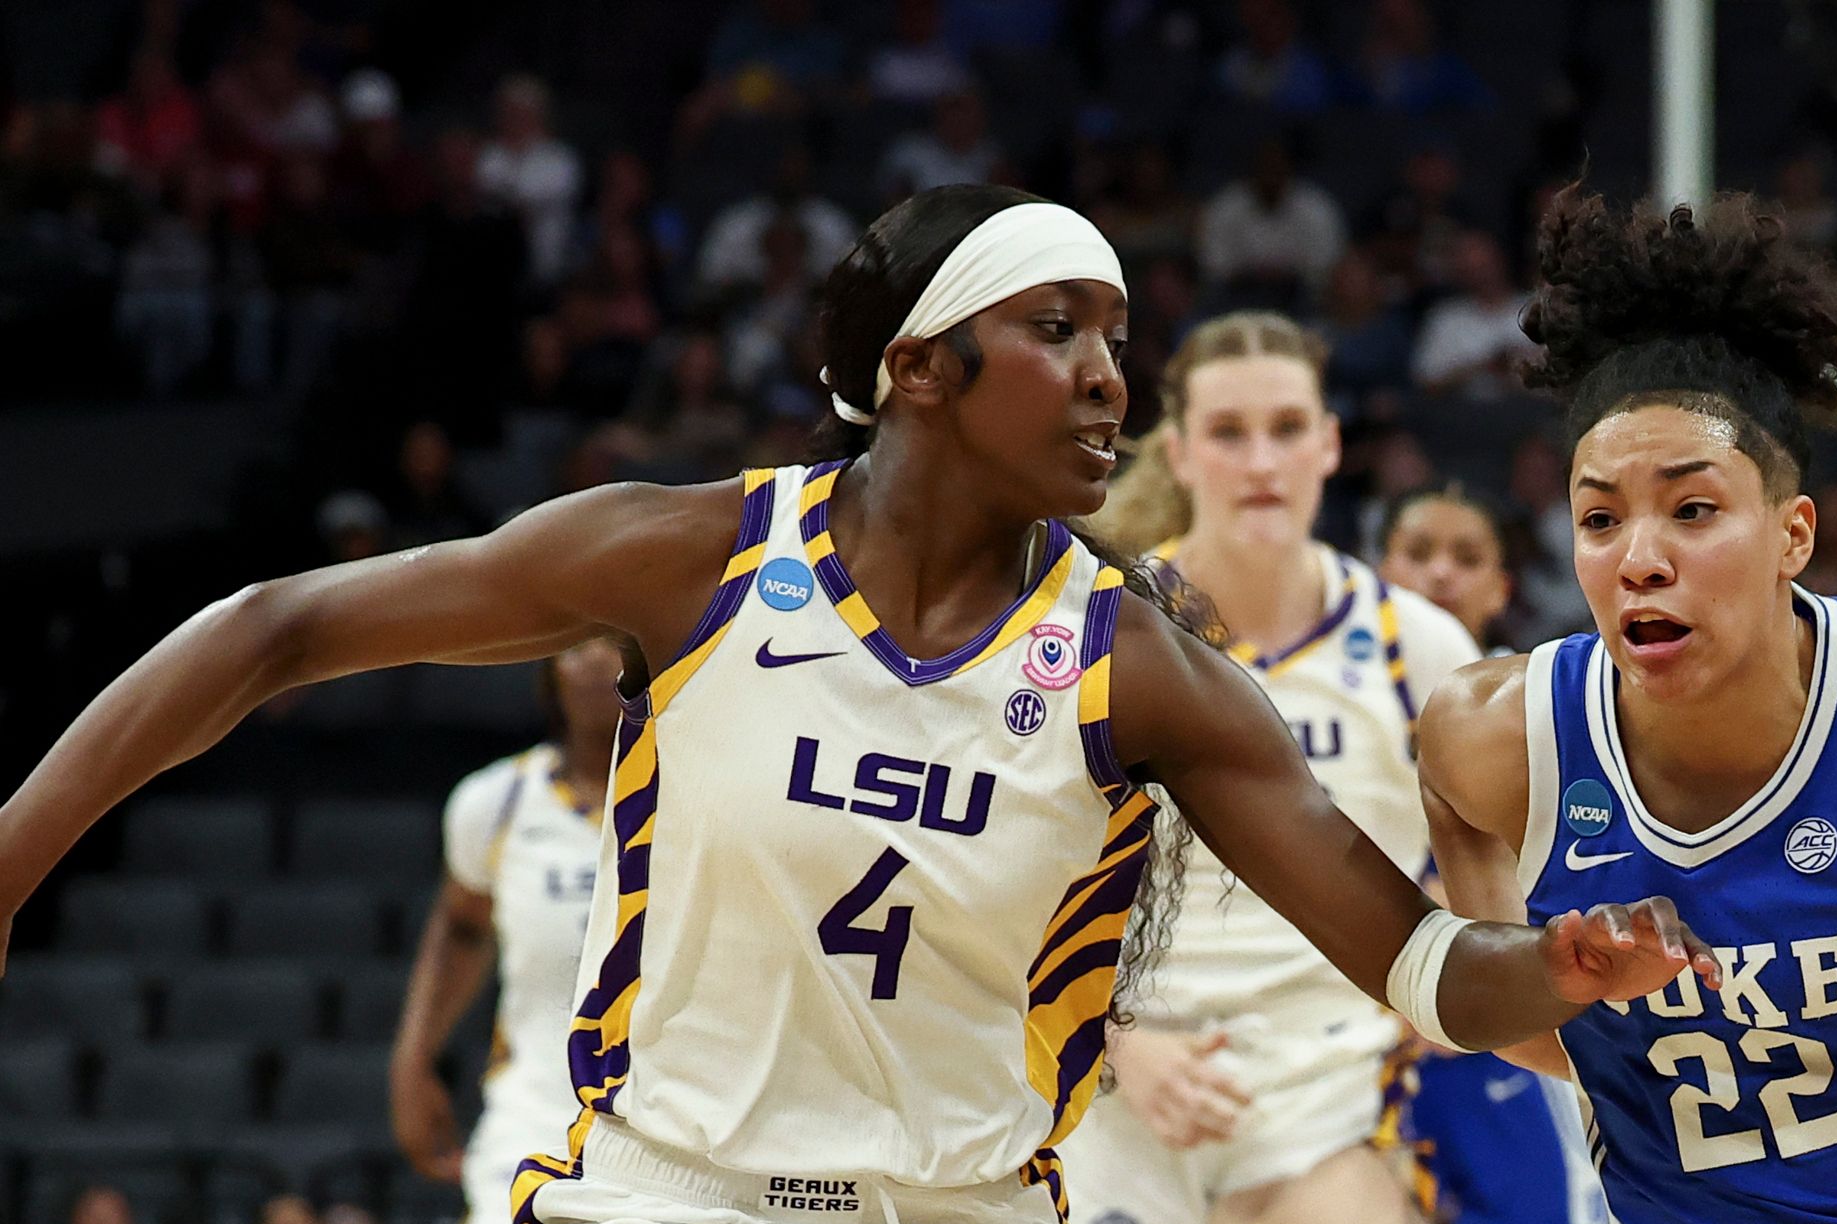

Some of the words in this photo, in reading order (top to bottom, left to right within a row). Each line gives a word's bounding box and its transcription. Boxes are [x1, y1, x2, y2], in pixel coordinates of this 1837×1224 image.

[764, 579, 808, 600] NCAA
[1009, 694, 1042, 731] SEC
[787, 736, 996, 836] LSU
[1569, 804, 1609, 824] NCAA
[1792, 834, 1835, 849] ACC
[817, 846, 914, 1000] 4
[769, 1176, 858, 1195] GEAUX
[764, 1194, 860, 1211] TIGERS
